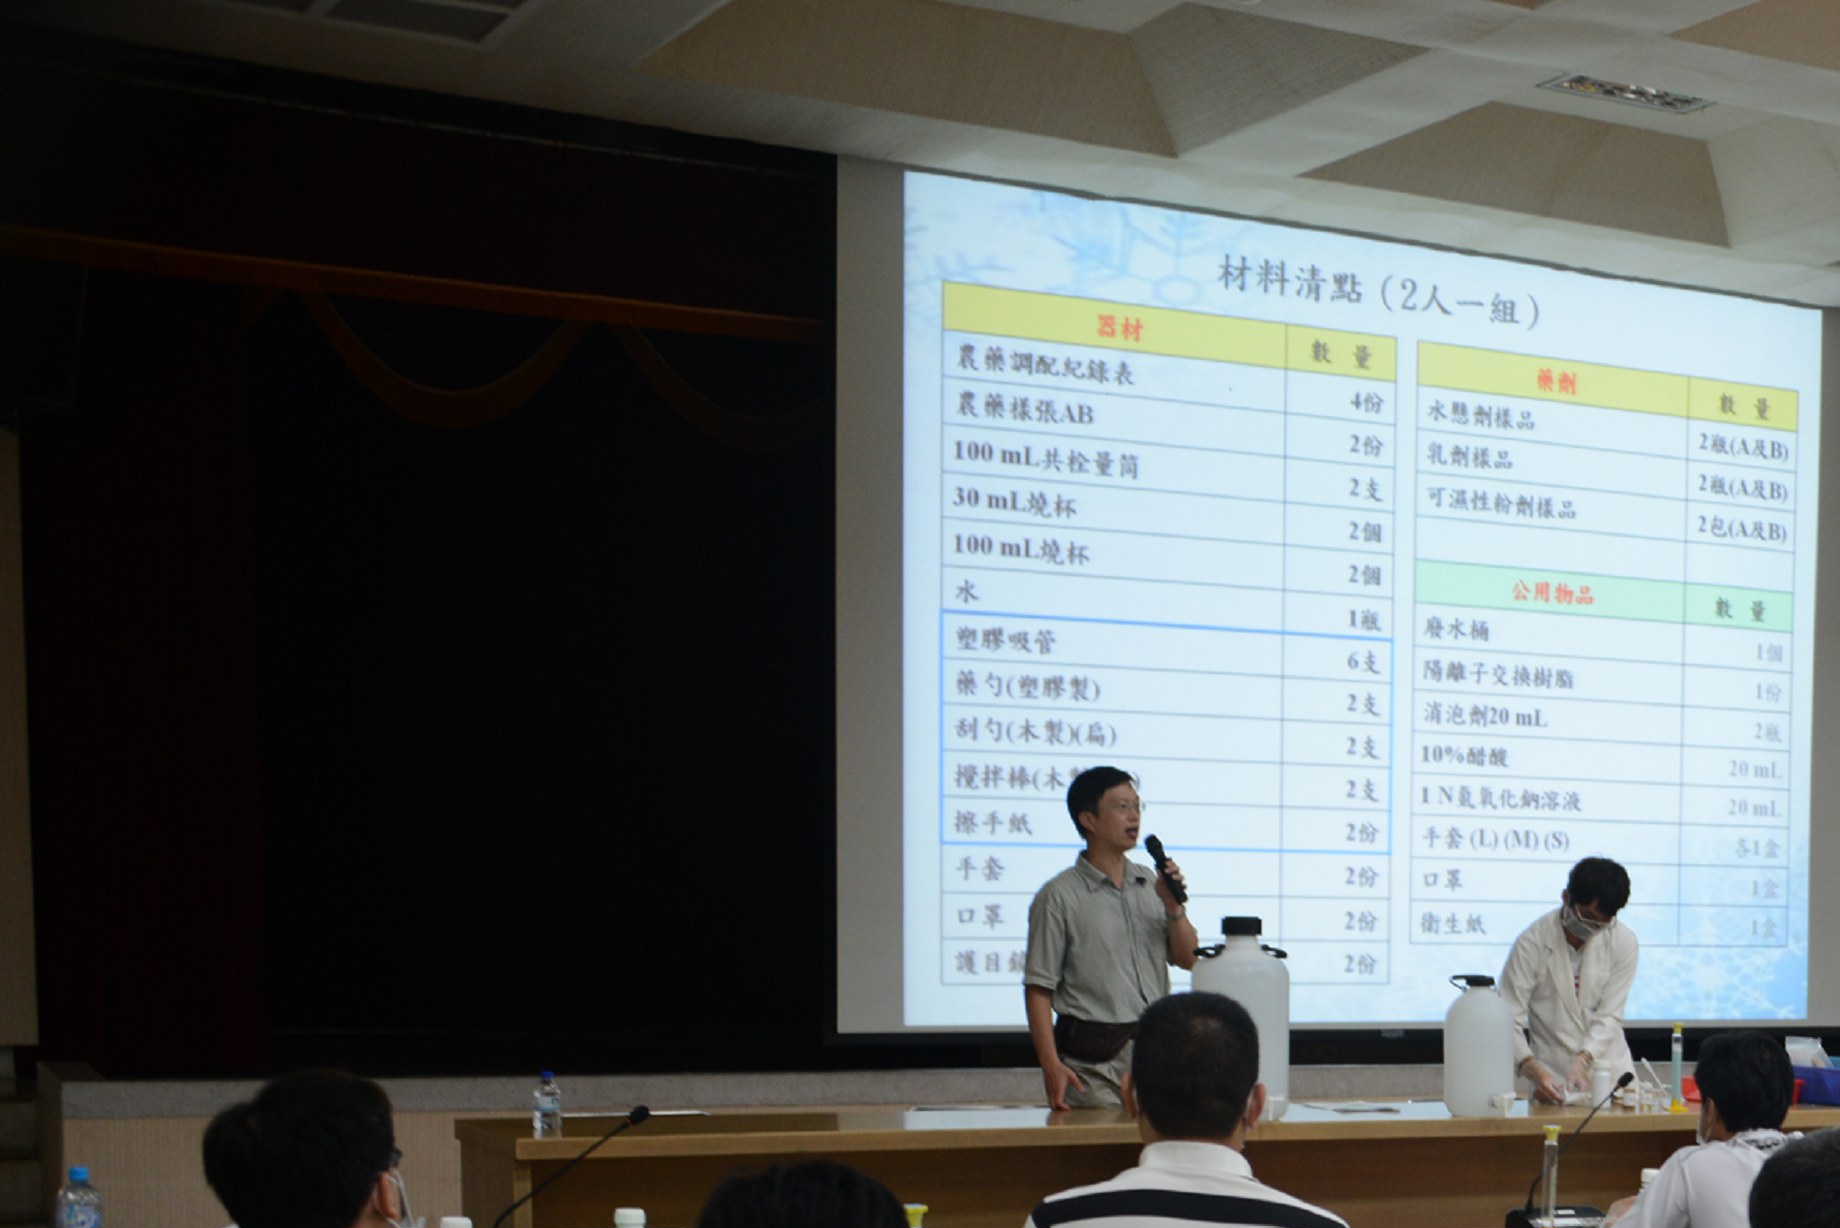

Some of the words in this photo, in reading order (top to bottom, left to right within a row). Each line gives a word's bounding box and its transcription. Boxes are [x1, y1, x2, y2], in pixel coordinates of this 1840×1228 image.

[1096, 313, 1144, 342] 器材
[957, 342, 1136, 387] 農藥調配紀錄表
[956, 389, 1095, 425] 農藥樣張AB
[1349, 392, 1385, 415] 4份
[1427, 398, 1536, 432] 水懸劑樣品
[1349, 433, 1385, 458] 2份
[1427, 443, 1513, 470] 乳劑樣品
[1348, 478, 1385, 503] 2支
[1348, 521, 1382, 544] 2個
[1348, 564, 1382, 587] 2個
[955, 579, 980, 602] 水
[1512, 579, 1595, 605] 公用物品
[955, 625, 1057, 656] 塑膠吸管
[1346, 650, 1382, 675] 6支
[1346, 693, 1382, 717] 2支
[1346, 735, 1381, 759] 2支
[1345, 779, 1381, 803] 2支
[953, 810, 1032, 837] 擦手紙
[1345, 821, 1379, 843] 2份
[955, 856, 1006, 884] 手套
[1344, 866, 1379, 888] 2份
[1423, 870, 1464, 890] 口罩
[957, 904, 1005, 930] 口罩
[1344, 910, 1378, 933] 2份
[1344, 952, 1378, 975] 2份
